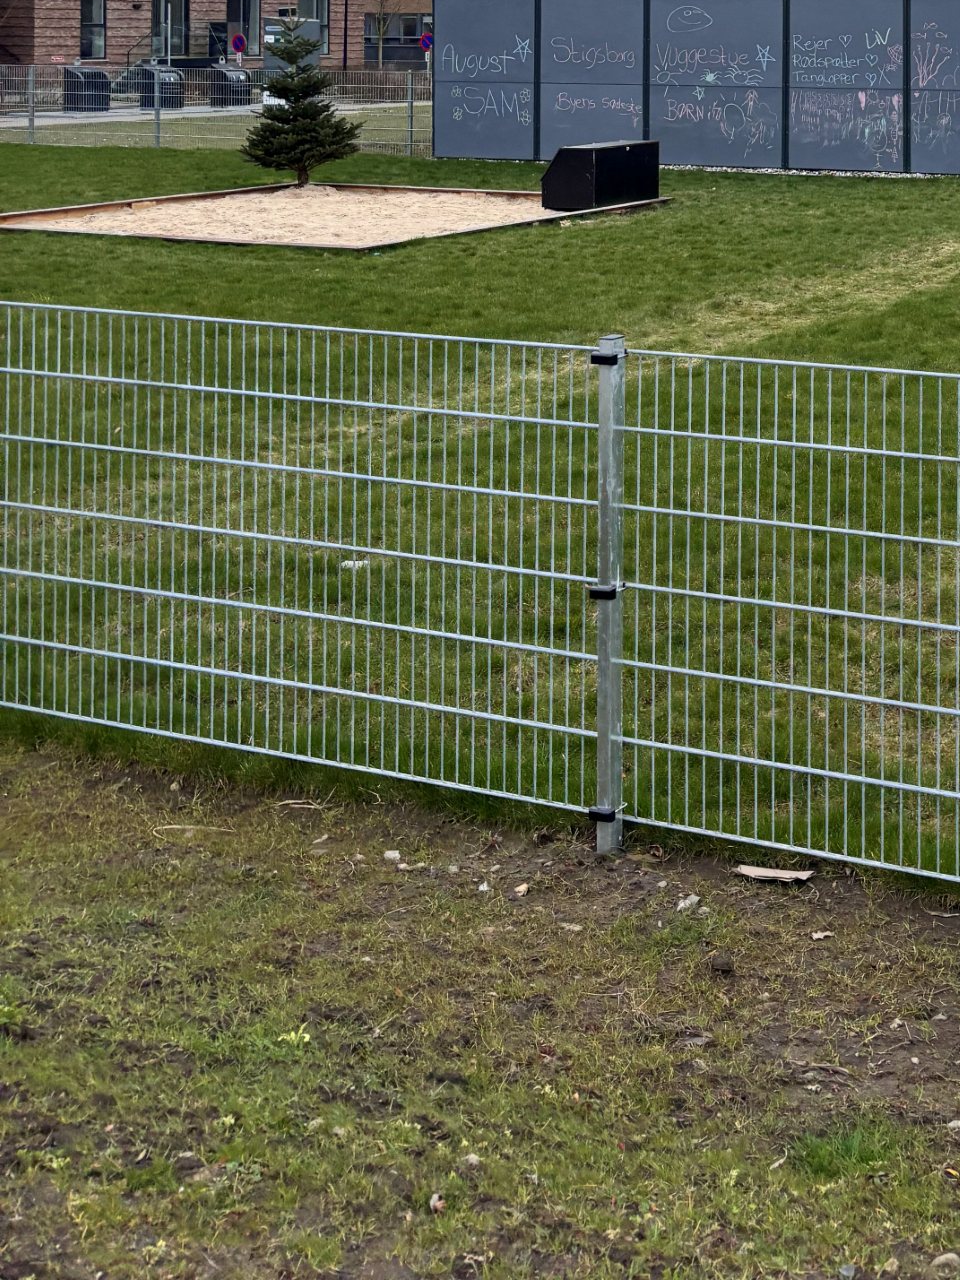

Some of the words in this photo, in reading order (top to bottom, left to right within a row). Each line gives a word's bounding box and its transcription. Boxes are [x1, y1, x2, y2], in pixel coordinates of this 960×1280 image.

[441, 43, 515, 78] August
[656, 42, 750, 74] Vuggestue
[792, 34, 833, 56] Rejer
[463, 86, 520, 121] SAM
[555, 91, 596, 114] Byens
